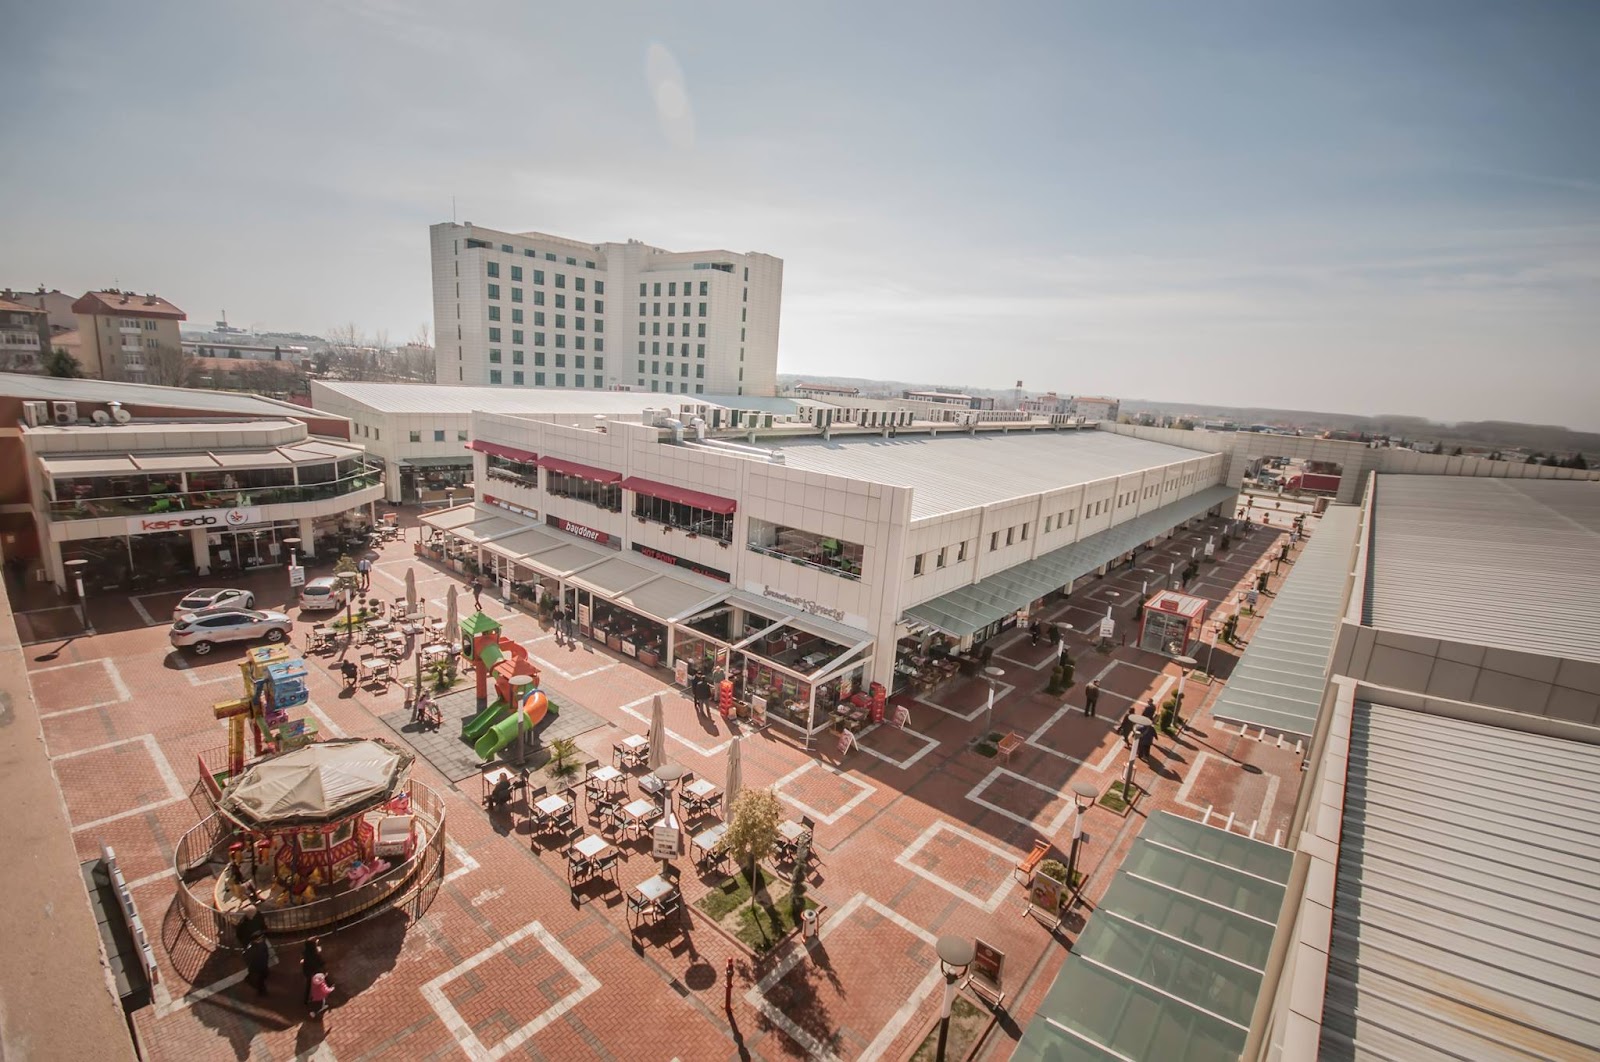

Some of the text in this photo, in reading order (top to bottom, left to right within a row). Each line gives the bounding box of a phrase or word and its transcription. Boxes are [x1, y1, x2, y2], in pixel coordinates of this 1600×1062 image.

[565, 522, 599, 540] baydöner
[642, 547, 677, 565] HOT POINT
